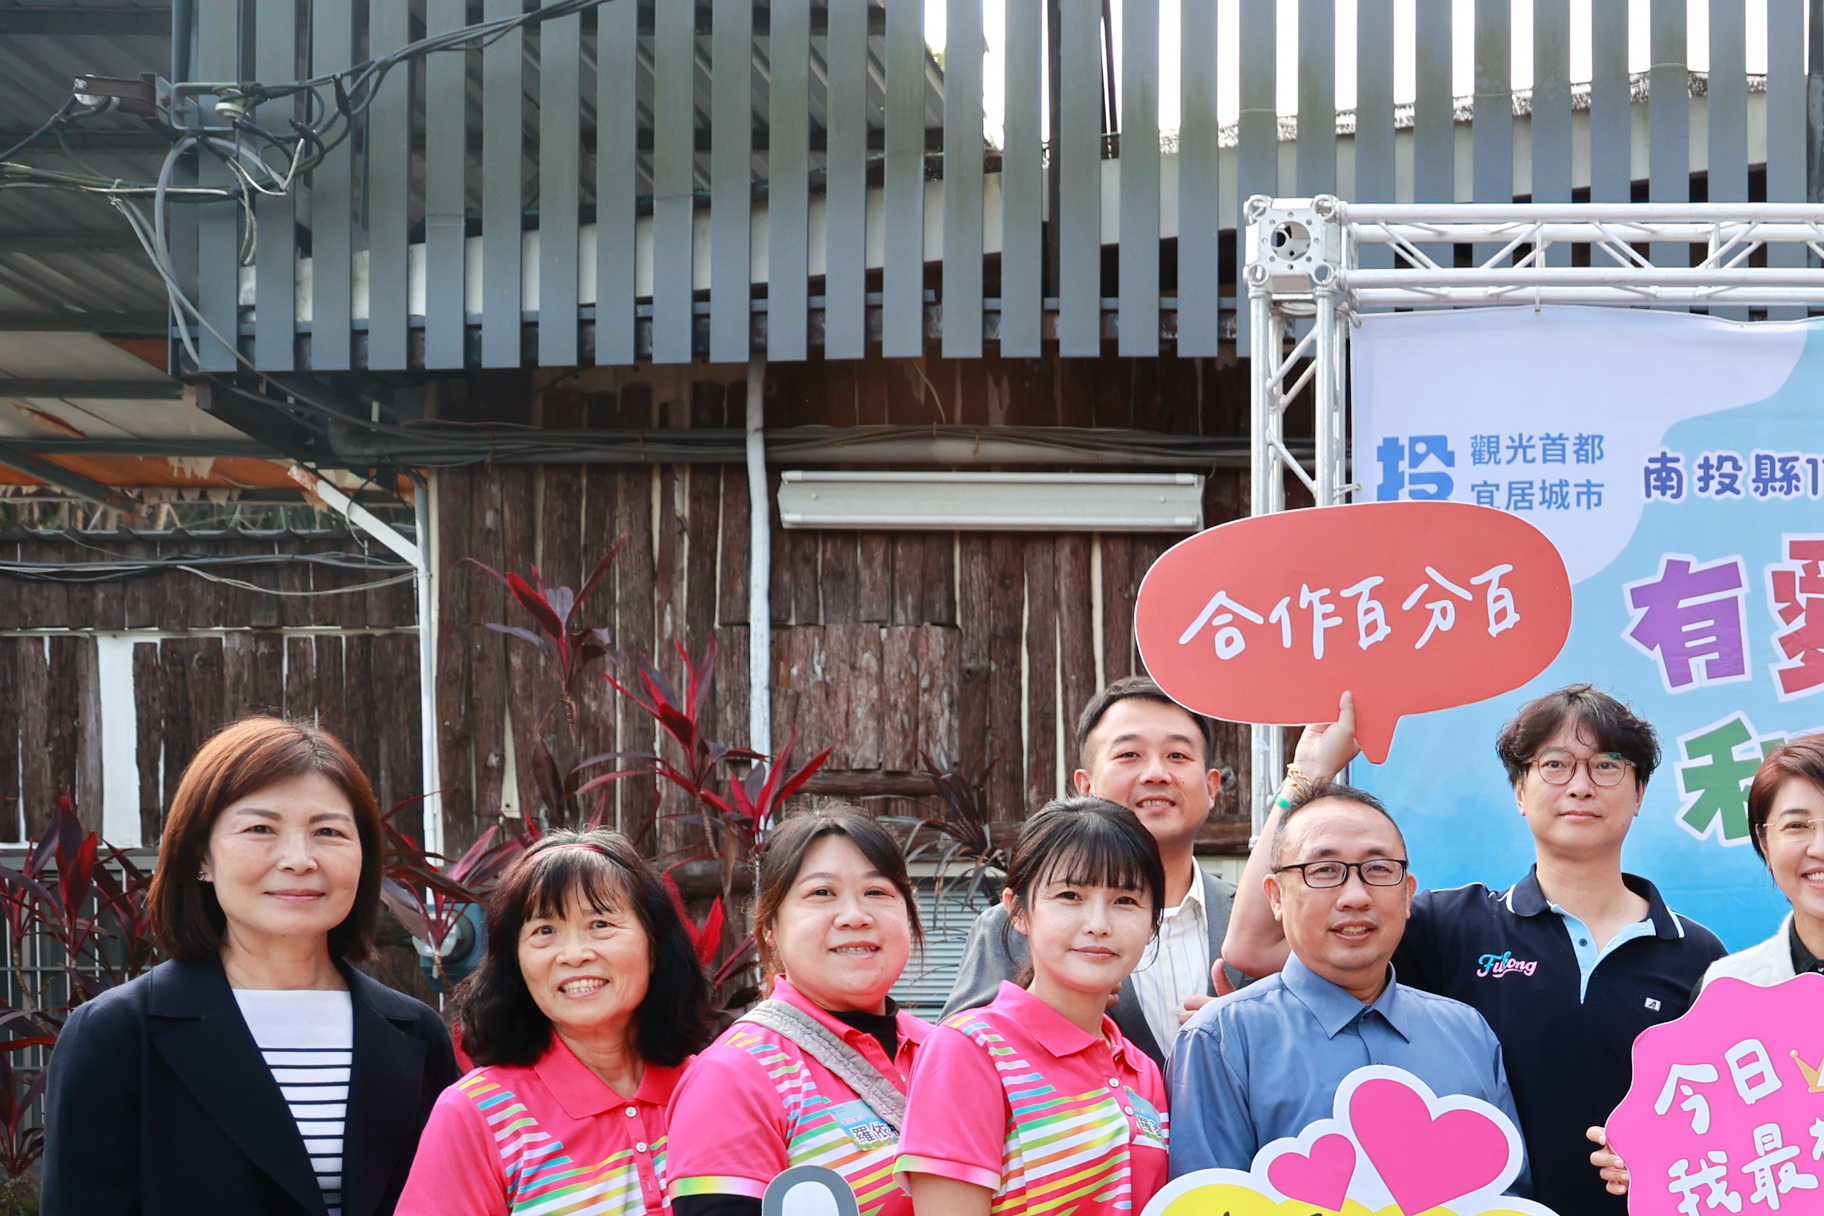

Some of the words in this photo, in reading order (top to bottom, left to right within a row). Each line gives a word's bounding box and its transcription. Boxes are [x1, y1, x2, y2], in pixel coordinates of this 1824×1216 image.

[1470, 432, 1604, 466] 觀光首都
[1470, 479, 1604, 511] 宜居城市
[1178, 563, 1521, 660] 合作百分百
[1653, 1037, 1783, 1135] 今日
